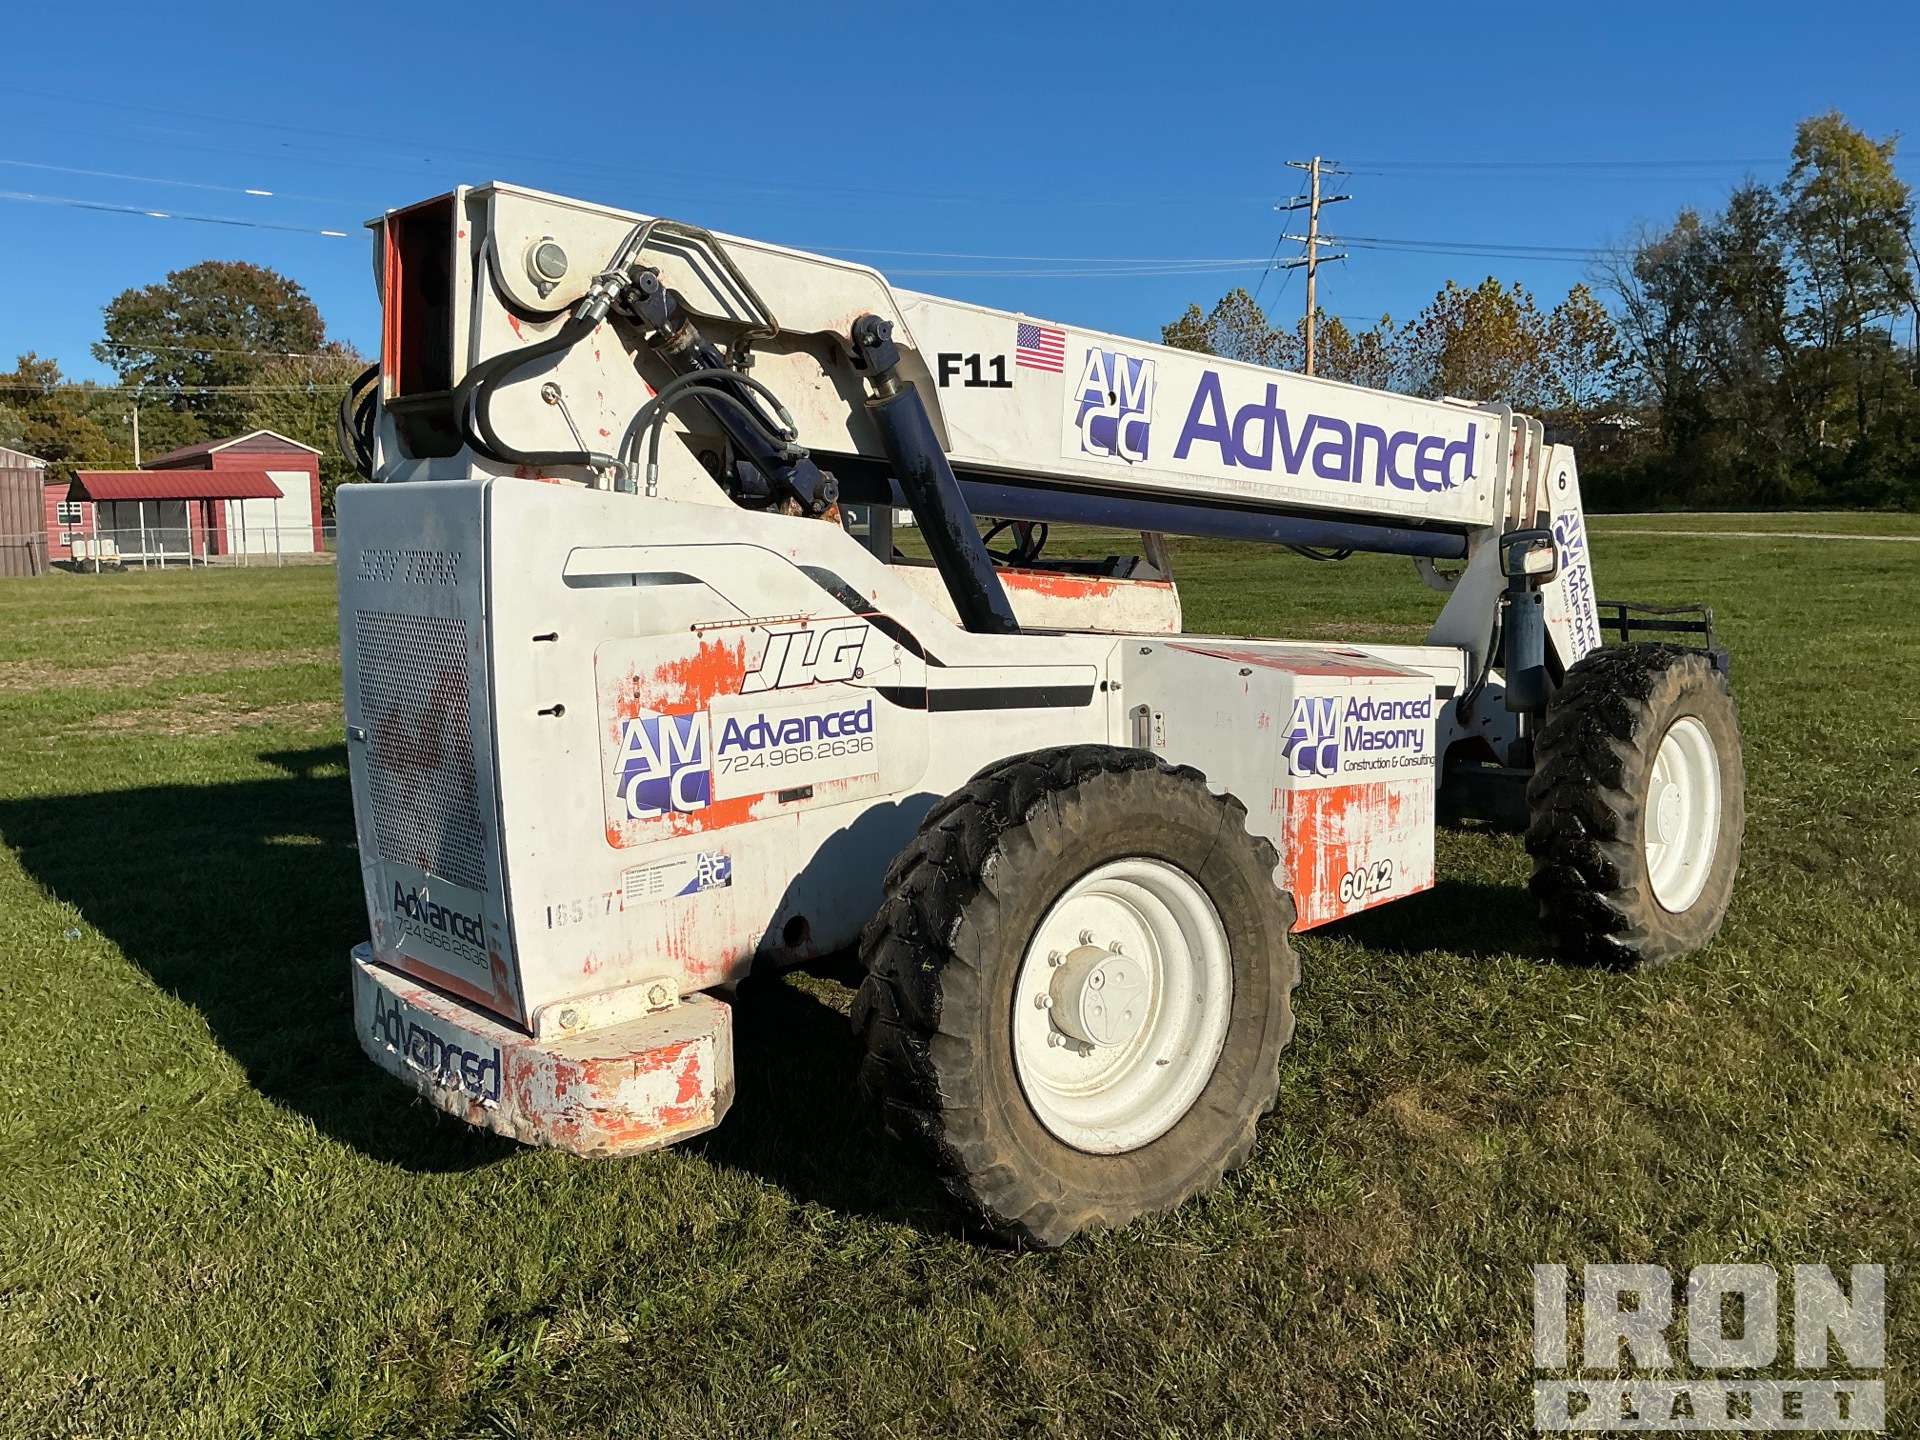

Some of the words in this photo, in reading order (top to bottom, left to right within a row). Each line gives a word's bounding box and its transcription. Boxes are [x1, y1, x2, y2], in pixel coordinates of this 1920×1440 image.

[938, 353, 1012, 388] F11
[1173, 370, 1477, 492] Advanced
[1558, 471, 1566, 490] 6
[1577, 565, 1596, 650] Advance
[739, 625, 870, 695] JLG
[718, 700, 873, 755] Advanced
[1344, 694, 1431, 722] Advanced
[718, 737, 873, 775] 724.966.2636
[1344, 726, 1424, 753] Masonry
[1344, 757, 1390, 771] Construction
[1391, 756, 1398, 768] &
[1400, 754, 1435, 768] Consulting
[1340, 859, 1393, 903] 6042
[394, 881, 486, 950] Advanced
[395, 916, 489, 970] 724.966.2636
[372, 987, 500, 1101] Advanced
